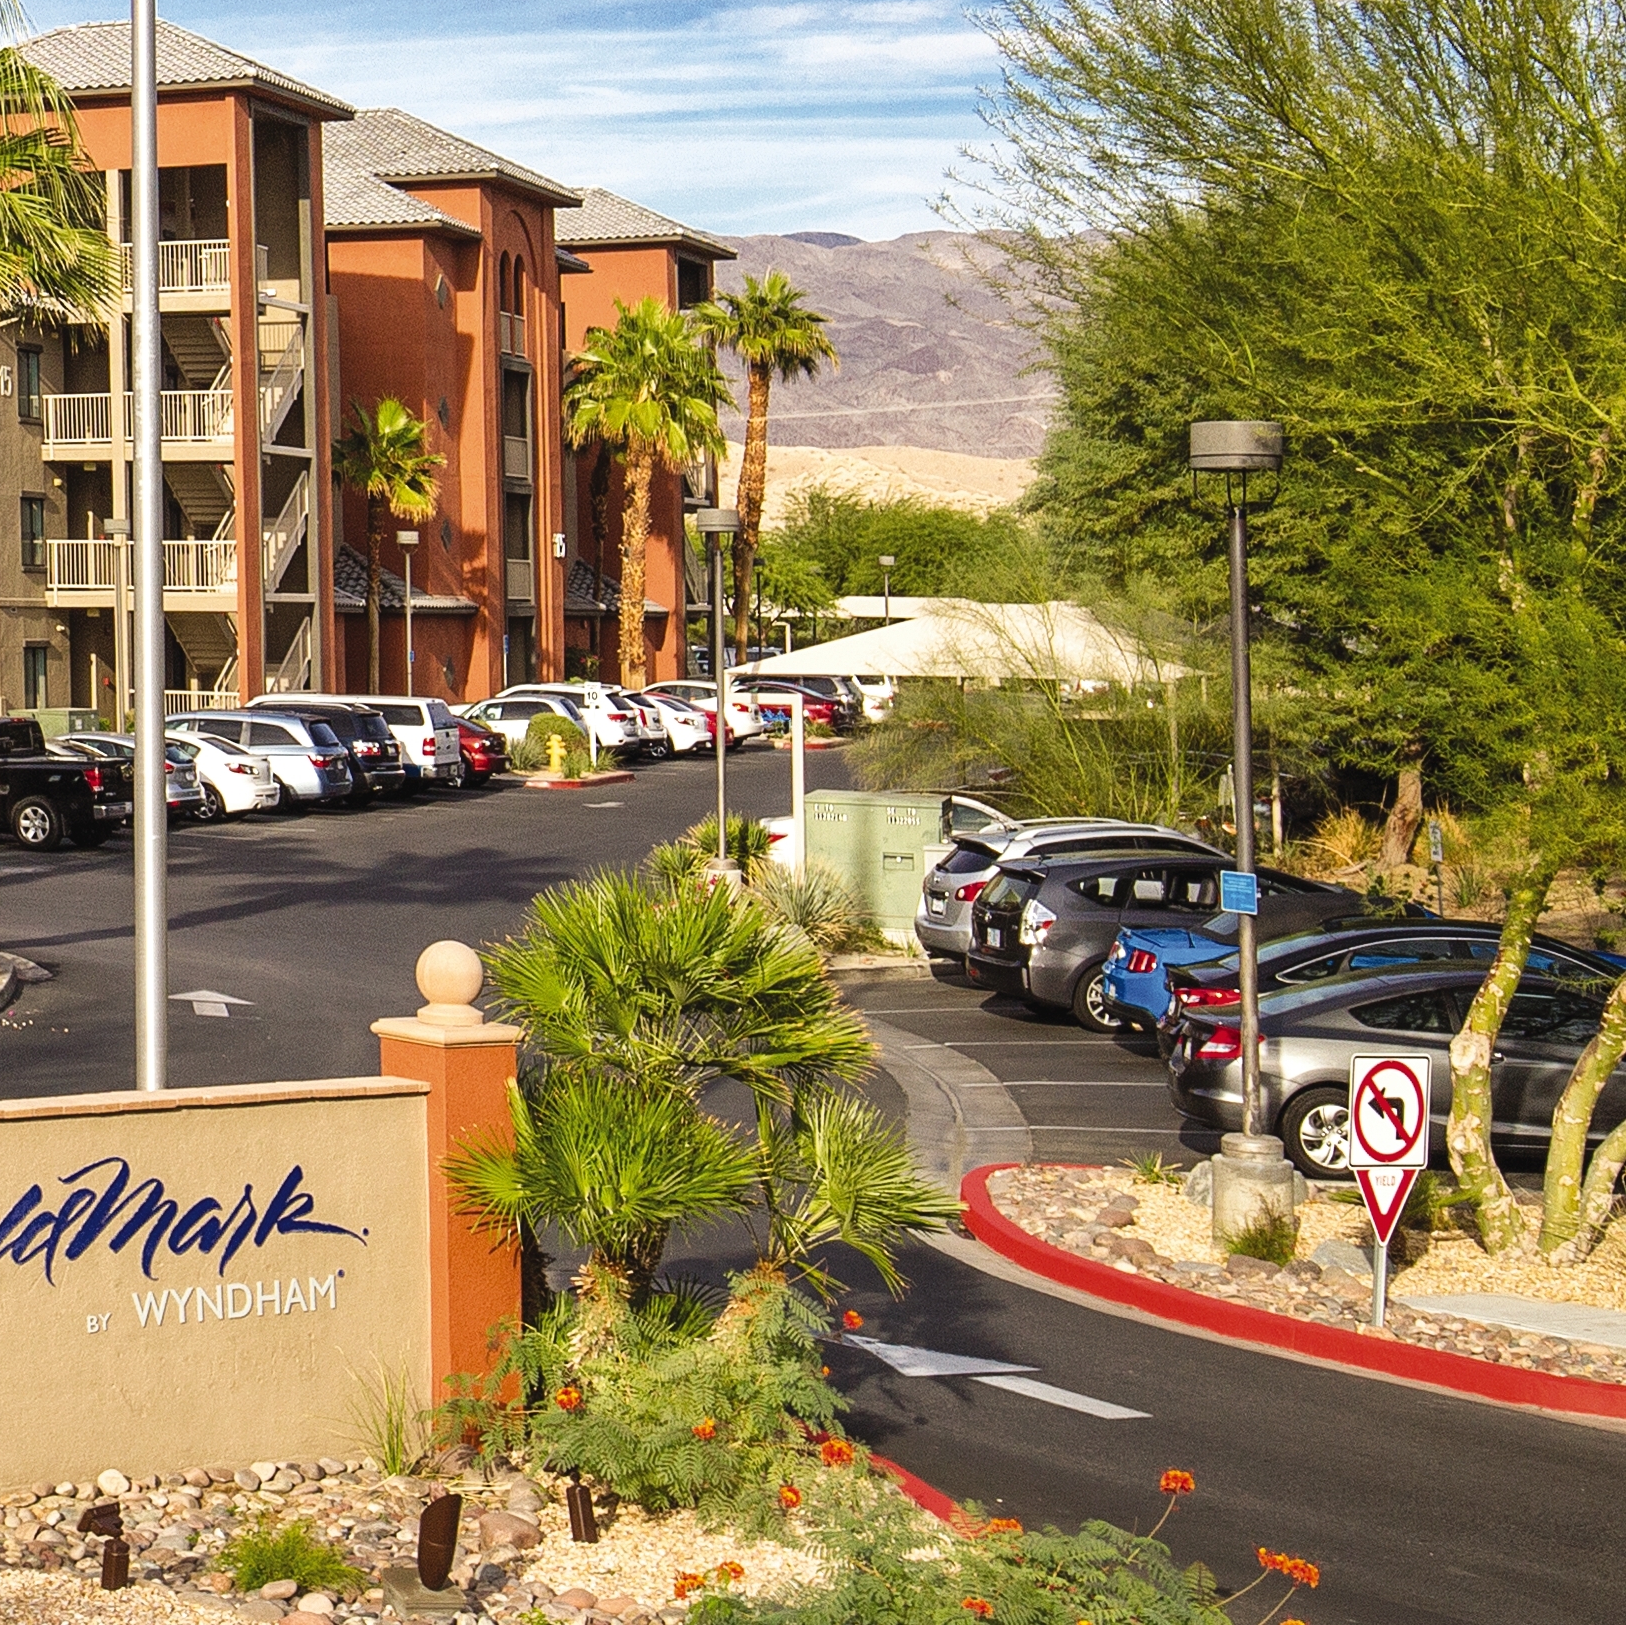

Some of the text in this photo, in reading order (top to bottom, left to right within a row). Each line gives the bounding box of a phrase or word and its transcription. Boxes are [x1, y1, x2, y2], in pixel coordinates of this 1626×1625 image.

[587, 691, 598, 701] 10
[1375, 1175, 1396, 1186] YIELD
[86, 1274, 337, 1333] BY WYNDHAM
